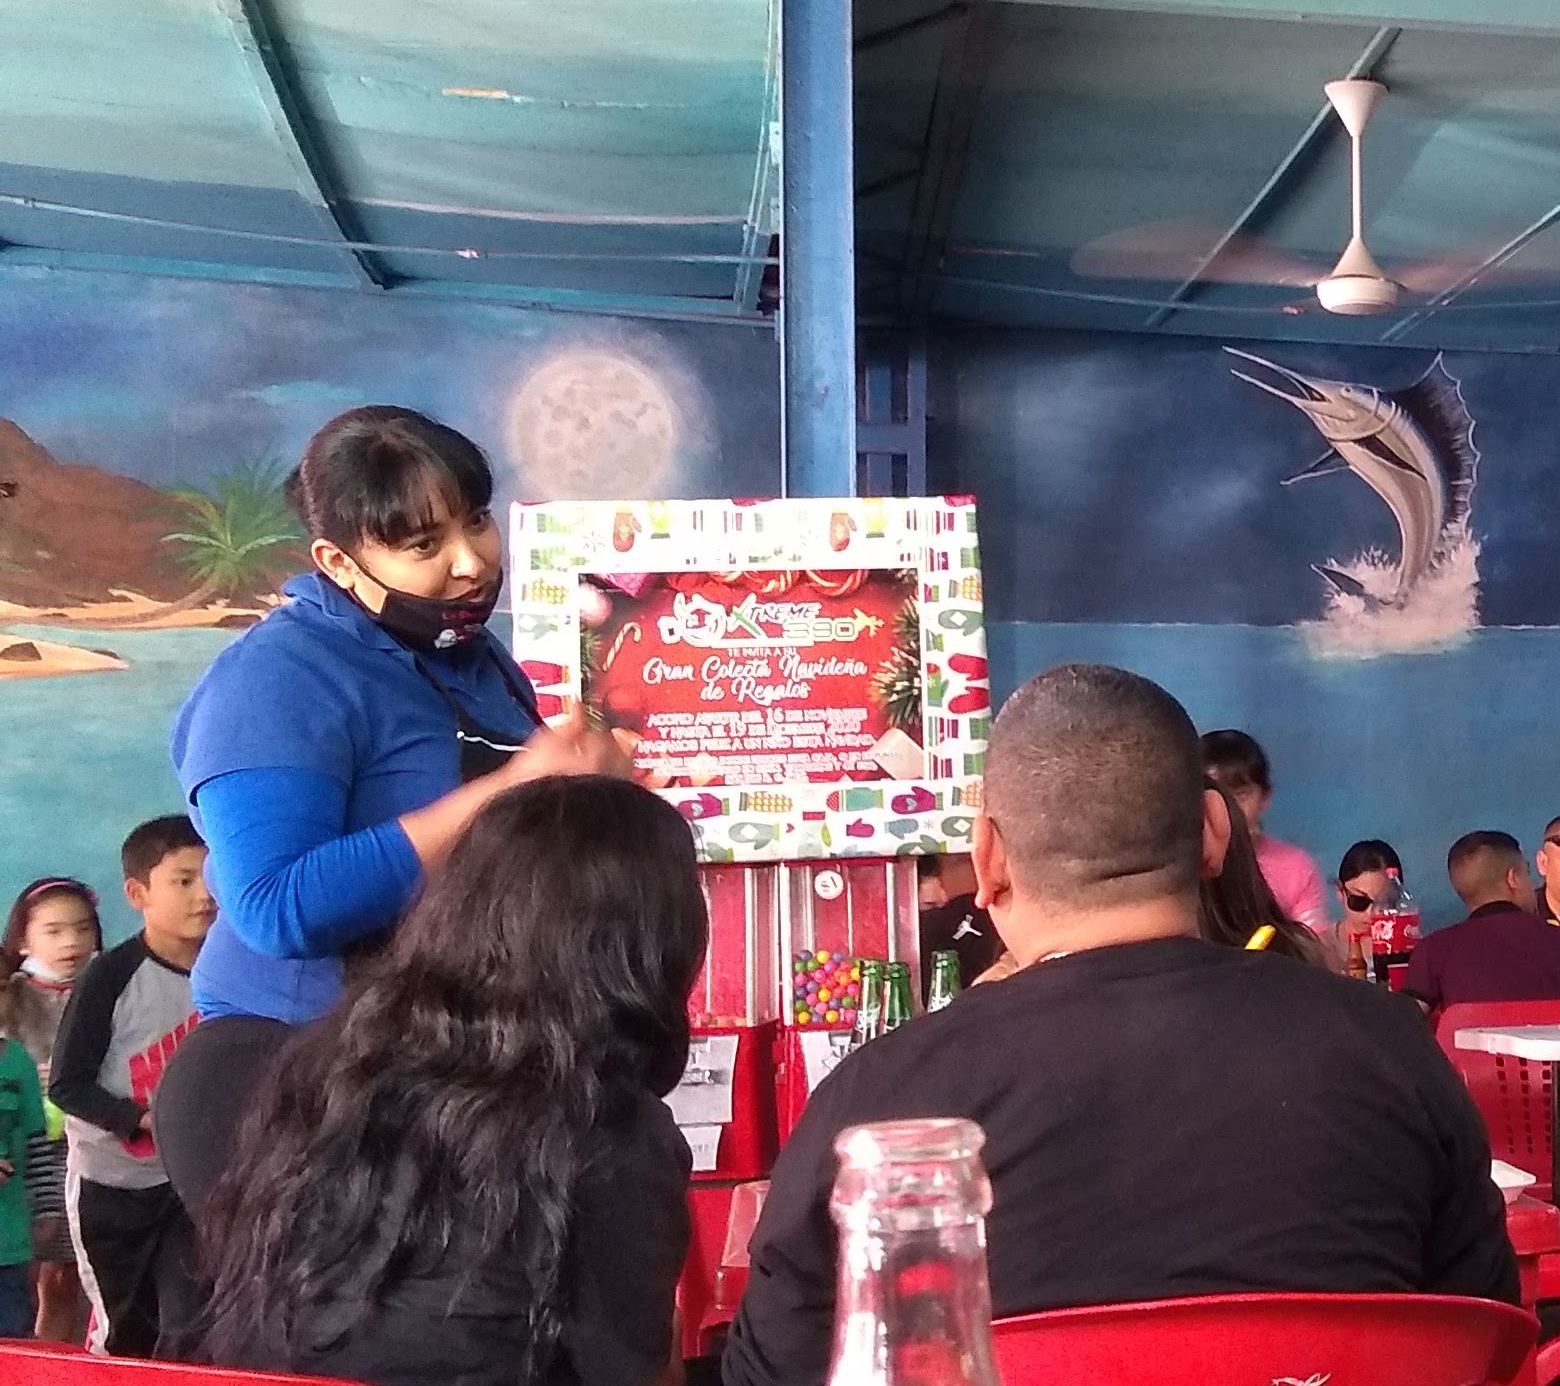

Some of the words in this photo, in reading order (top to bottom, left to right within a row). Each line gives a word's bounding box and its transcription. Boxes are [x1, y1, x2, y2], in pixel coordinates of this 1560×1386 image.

[642, 657, 695, 684] Gran
[701, 655, 772, 681] Colecta
[779, 655, 868, 682] Navideña
[700, 680, 726, 701] de
[731, 676, 812, 706] Regalos
